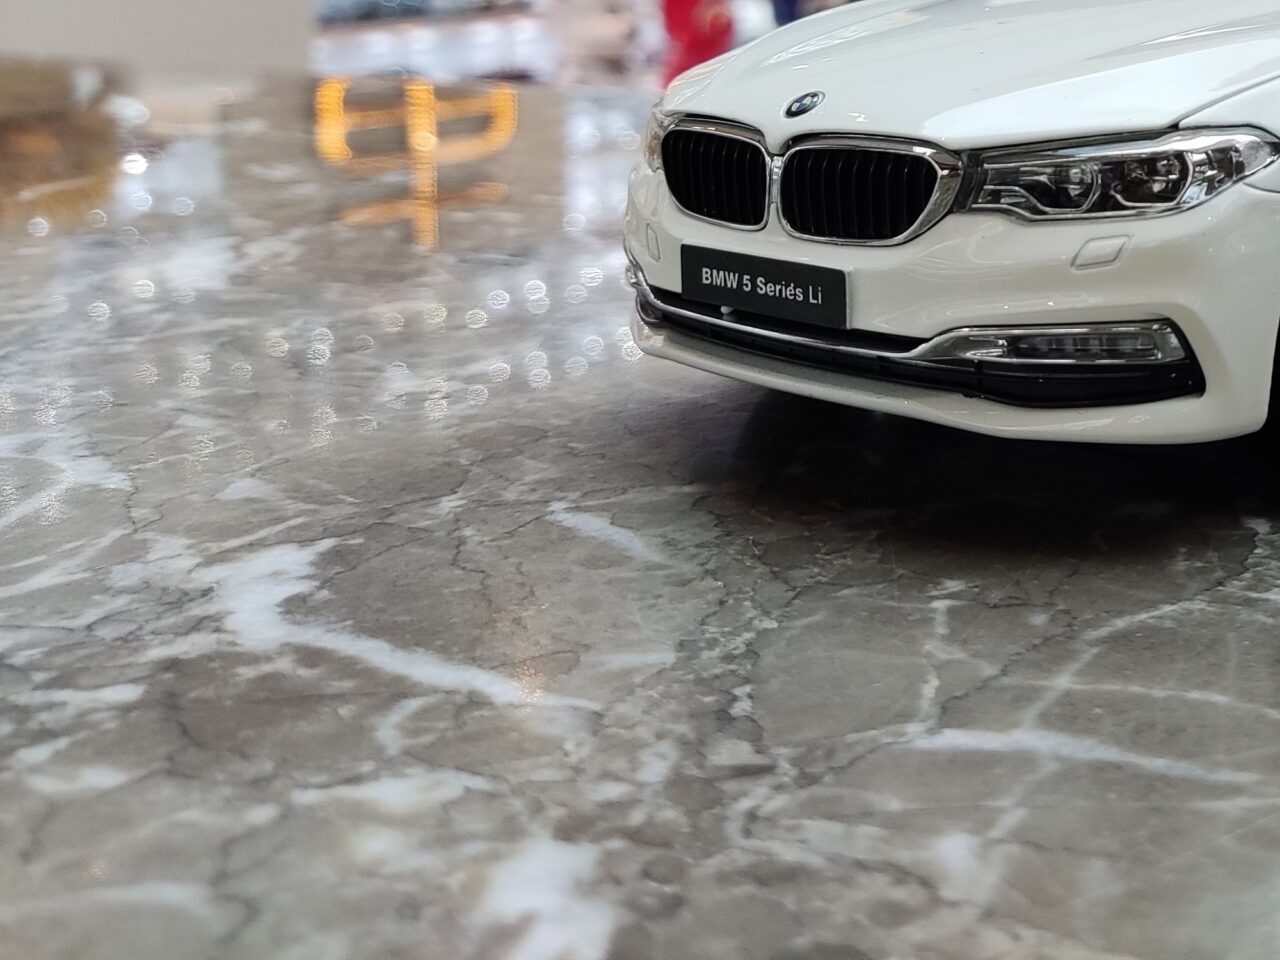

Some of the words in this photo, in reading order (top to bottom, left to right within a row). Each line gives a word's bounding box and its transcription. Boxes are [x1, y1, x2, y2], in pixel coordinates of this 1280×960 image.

[702, 267, 738, 289] BMW
[742, 274, 751, 292] 5
[808, 285, 822, 305] Li
